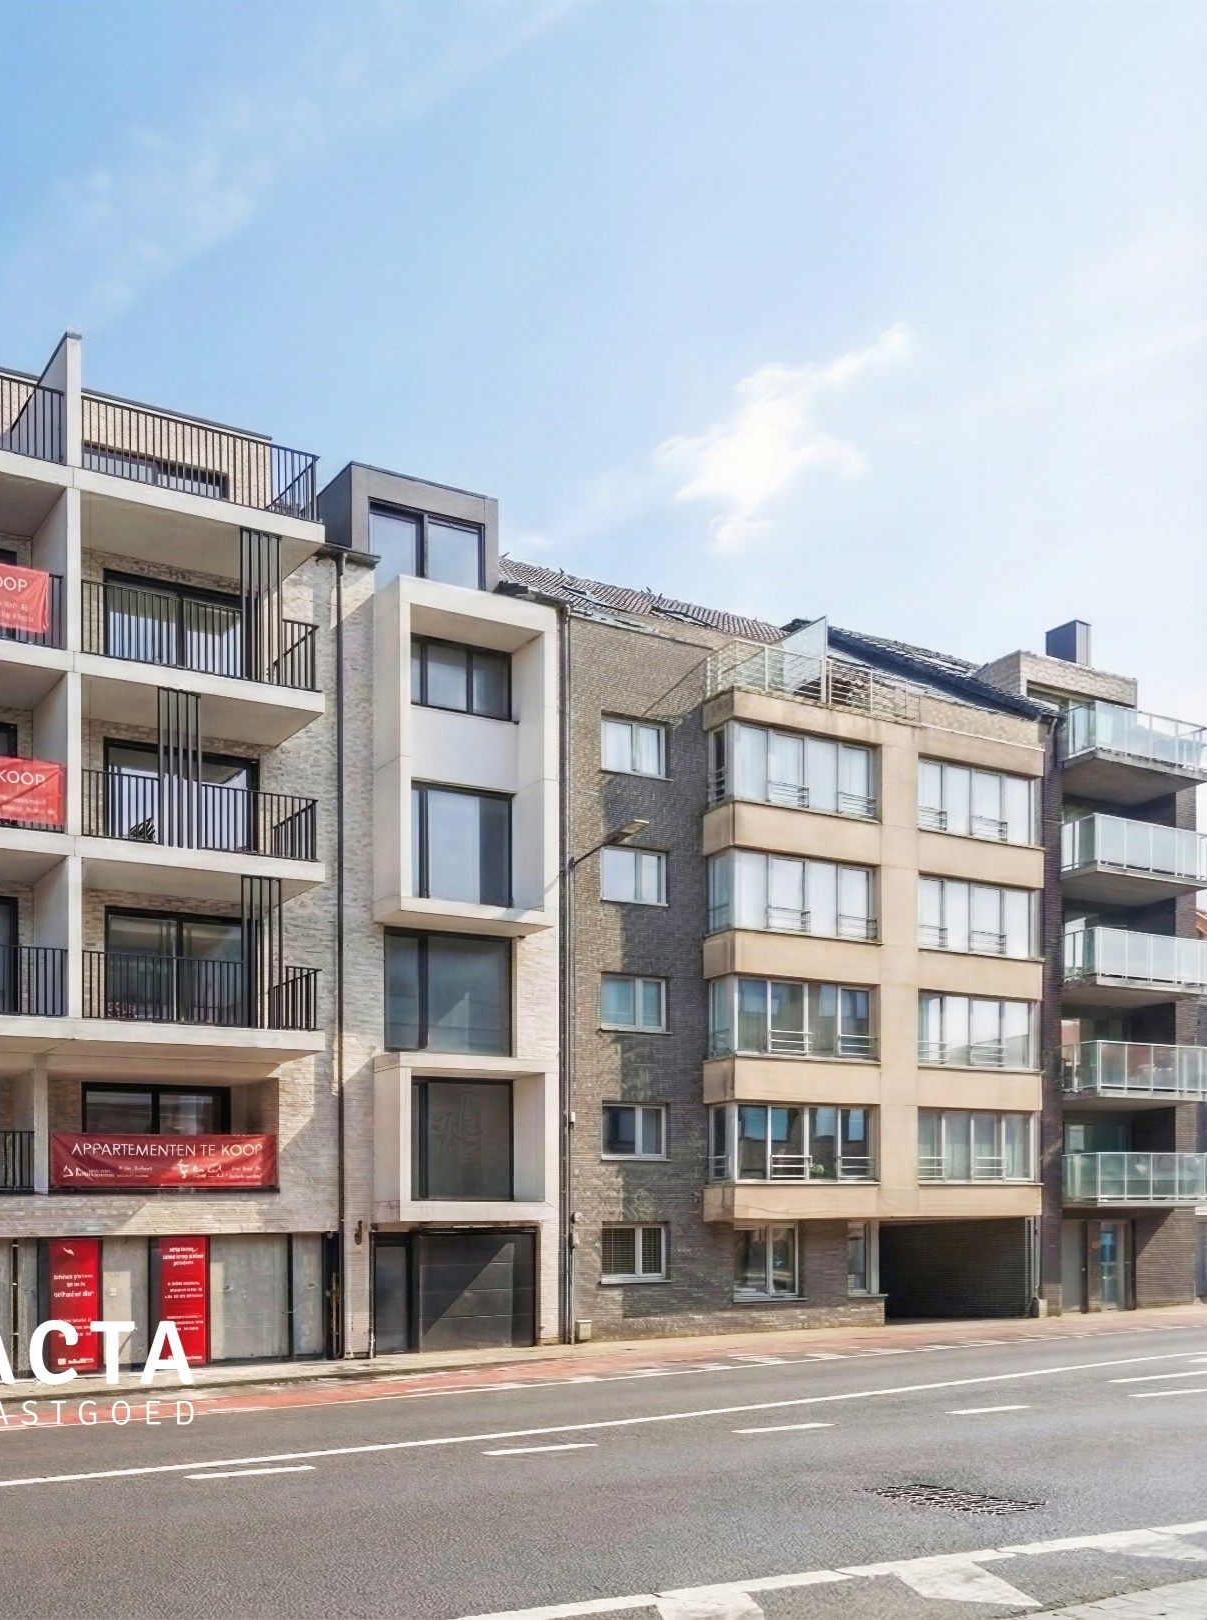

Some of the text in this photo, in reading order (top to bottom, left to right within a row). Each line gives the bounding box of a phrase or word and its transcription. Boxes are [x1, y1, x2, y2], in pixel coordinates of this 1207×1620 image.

[71, 1143, 262, 1157] APPARTEMENTEN TE KOOP
